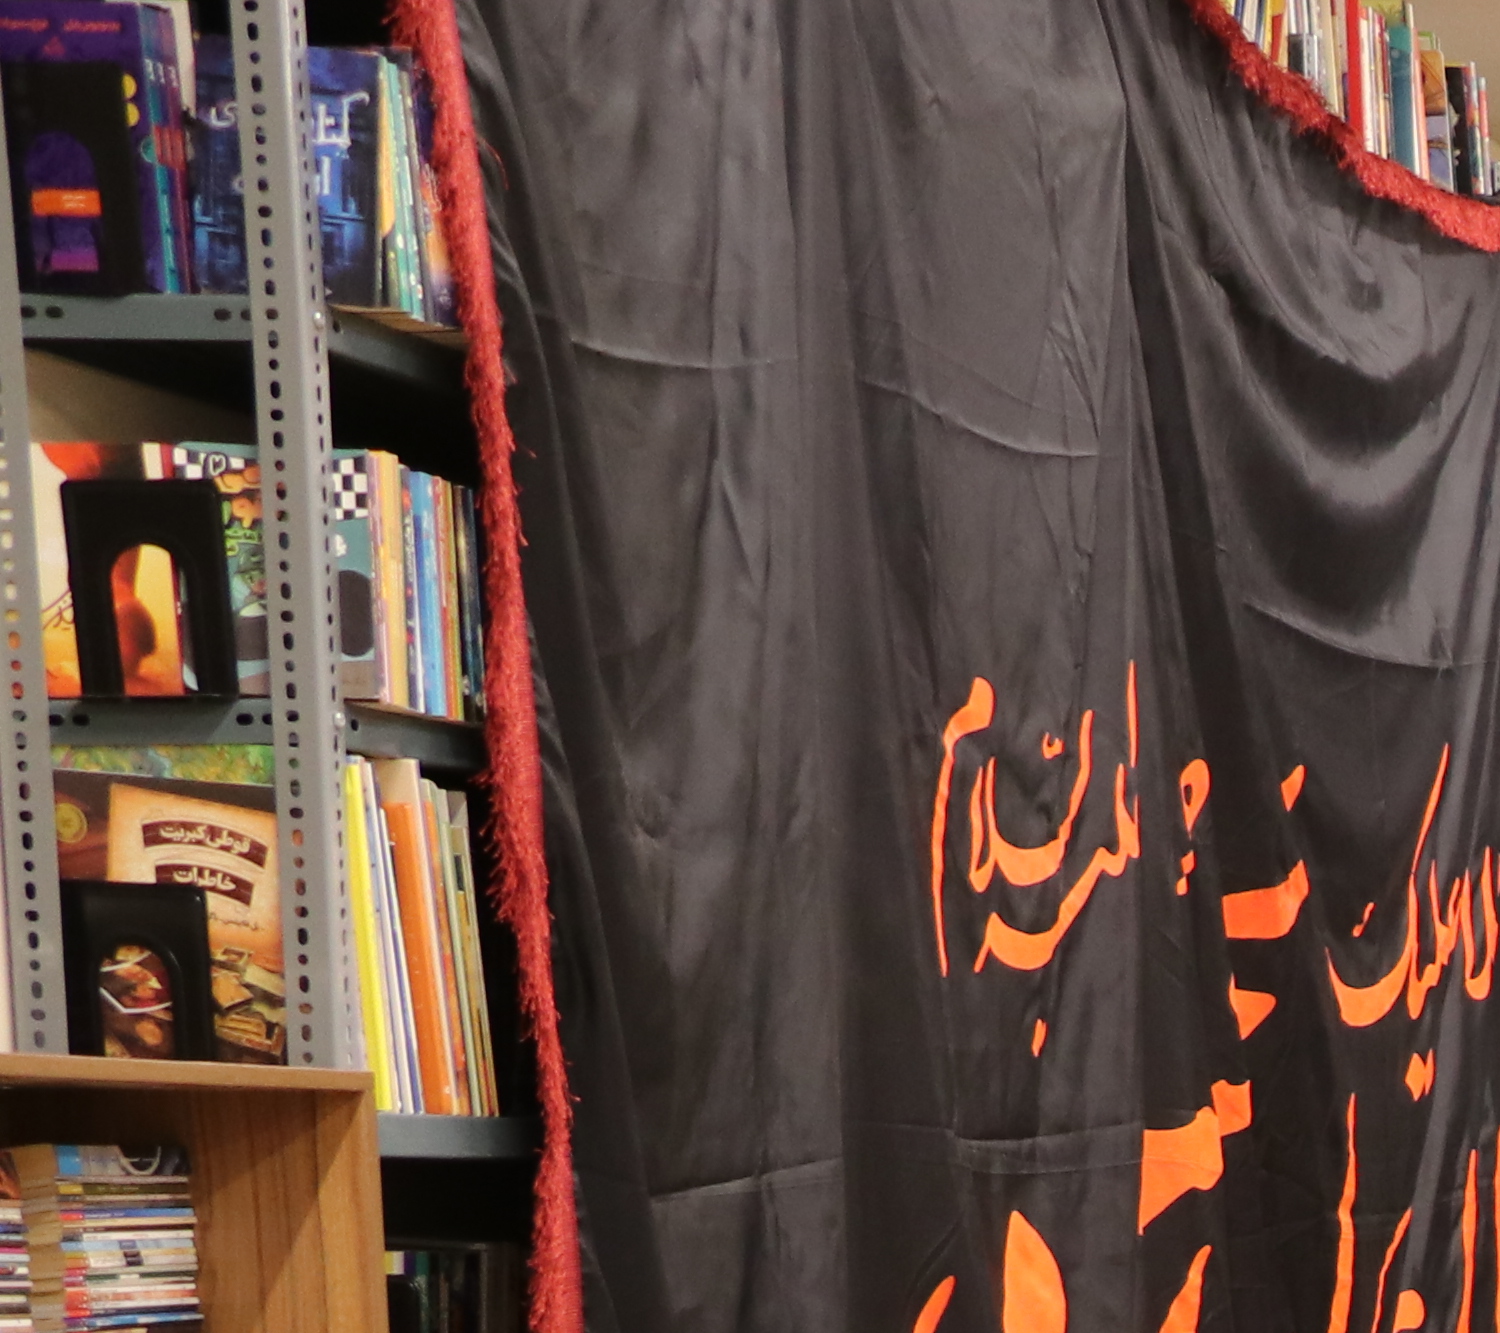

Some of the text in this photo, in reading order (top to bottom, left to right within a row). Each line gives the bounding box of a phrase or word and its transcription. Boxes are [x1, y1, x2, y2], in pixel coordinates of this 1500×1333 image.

[159, 825, 250, 854] قوطی کبریت
[173, 866, 236, 890] خاطرات
